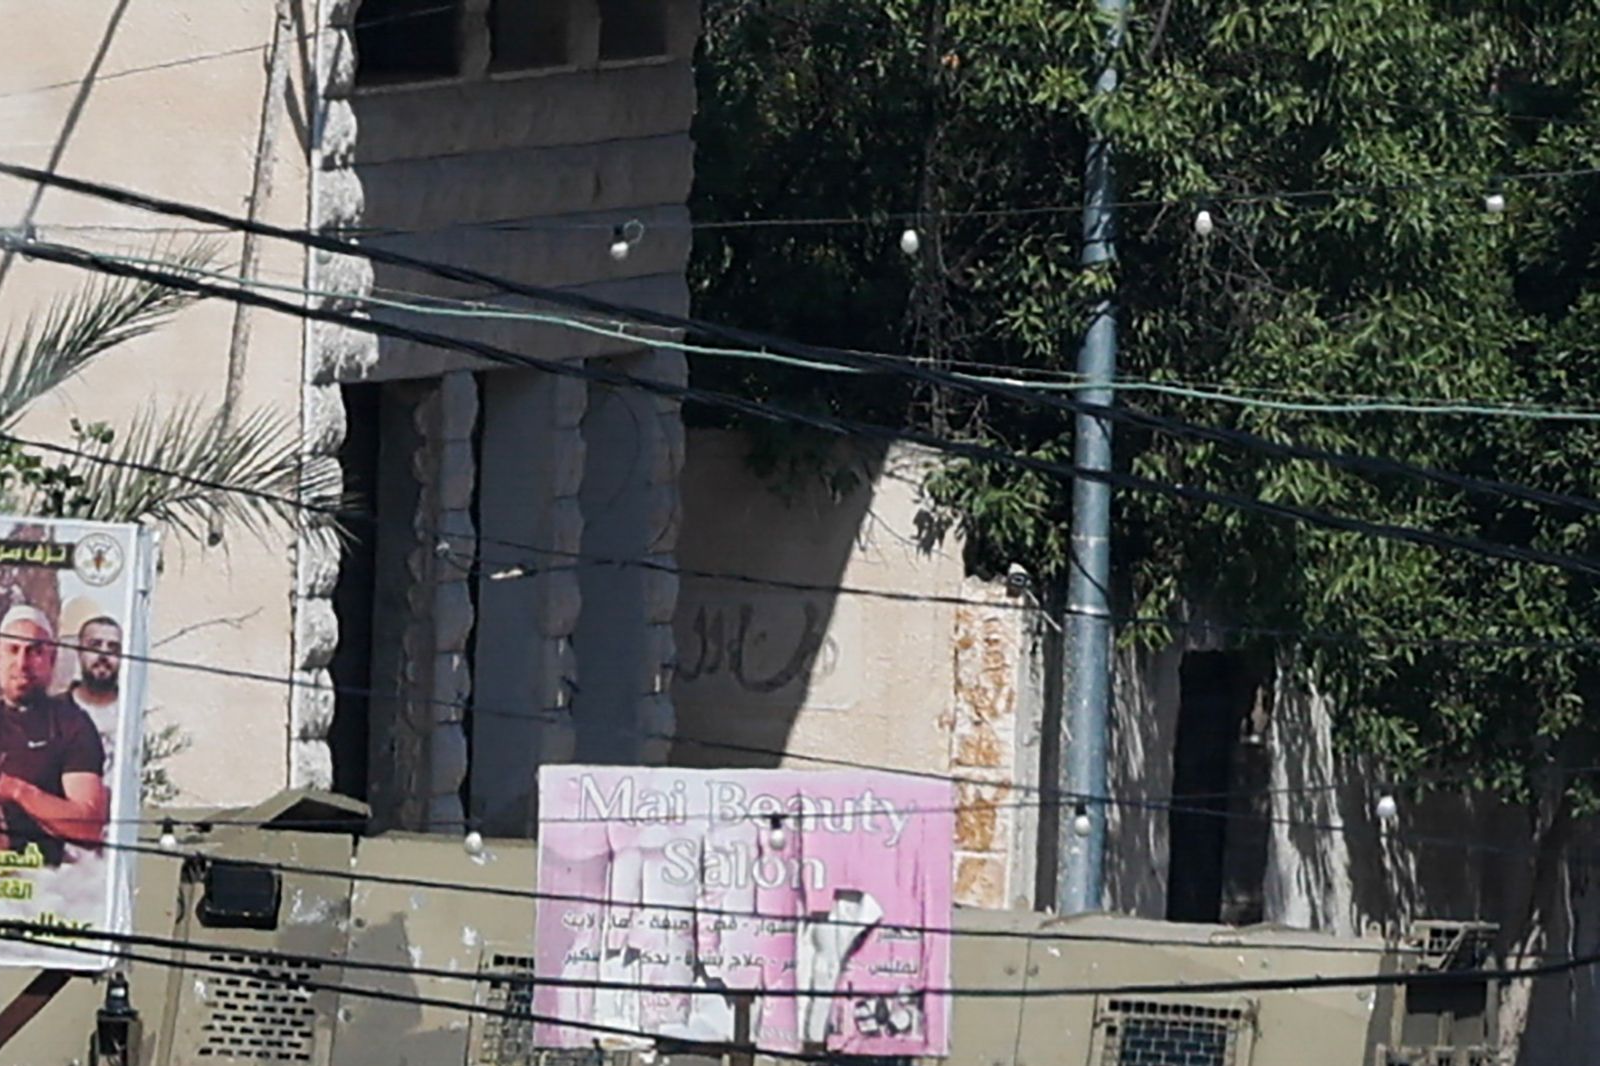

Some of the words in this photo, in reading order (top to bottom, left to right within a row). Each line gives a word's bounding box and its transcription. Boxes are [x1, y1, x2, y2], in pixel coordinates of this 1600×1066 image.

[578, 772, 687, 825] Mai
[705, 780, 915, 848] Beauty
[660, 837, 827, 890] Salon
